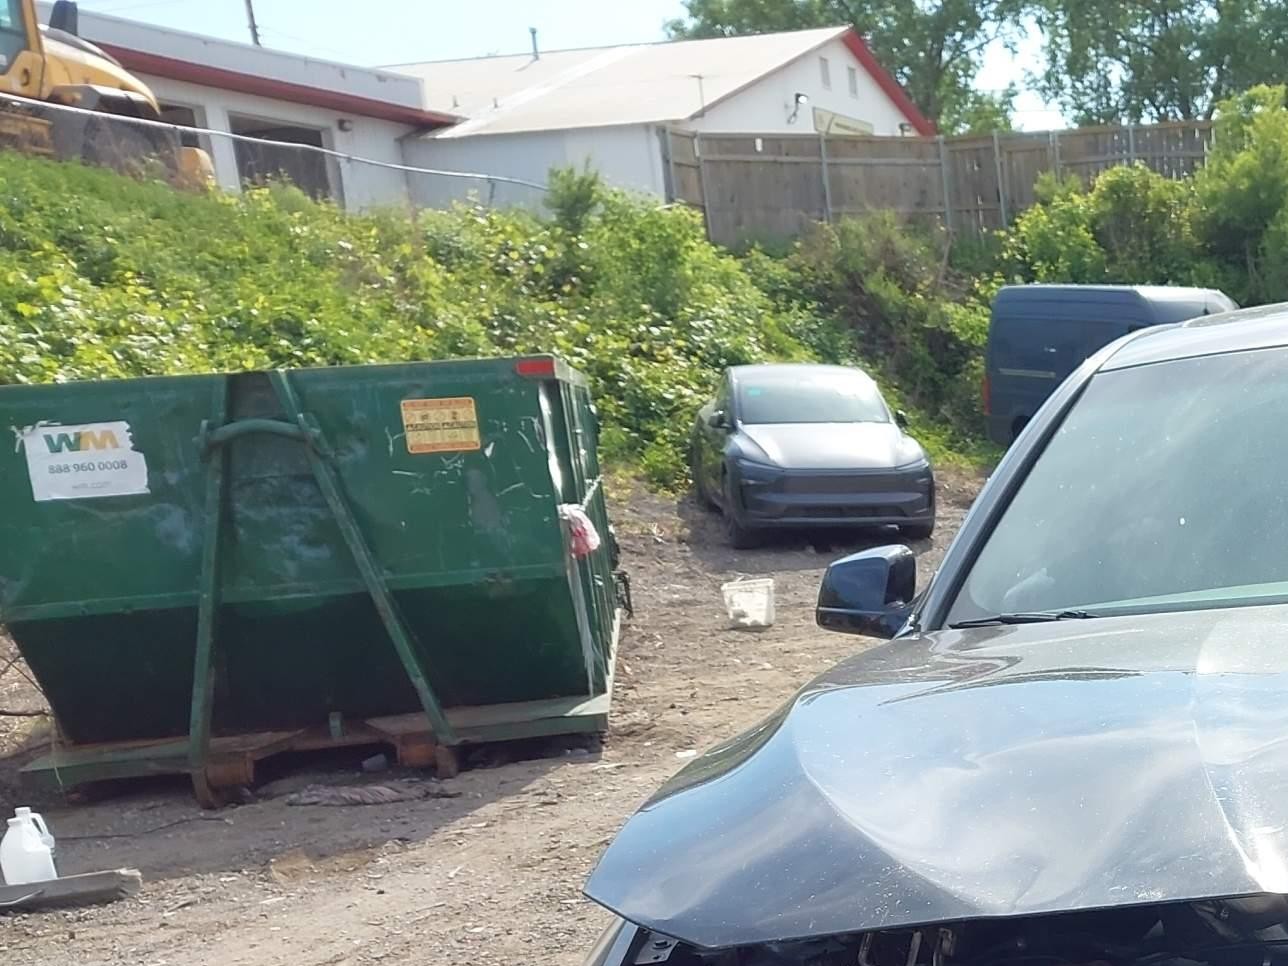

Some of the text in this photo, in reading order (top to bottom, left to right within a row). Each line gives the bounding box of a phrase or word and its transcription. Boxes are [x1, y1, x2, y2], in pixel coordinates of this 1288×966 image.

[43, 430, 119, 453] WM
[48, 460, 128, 475] 888 960 0008
